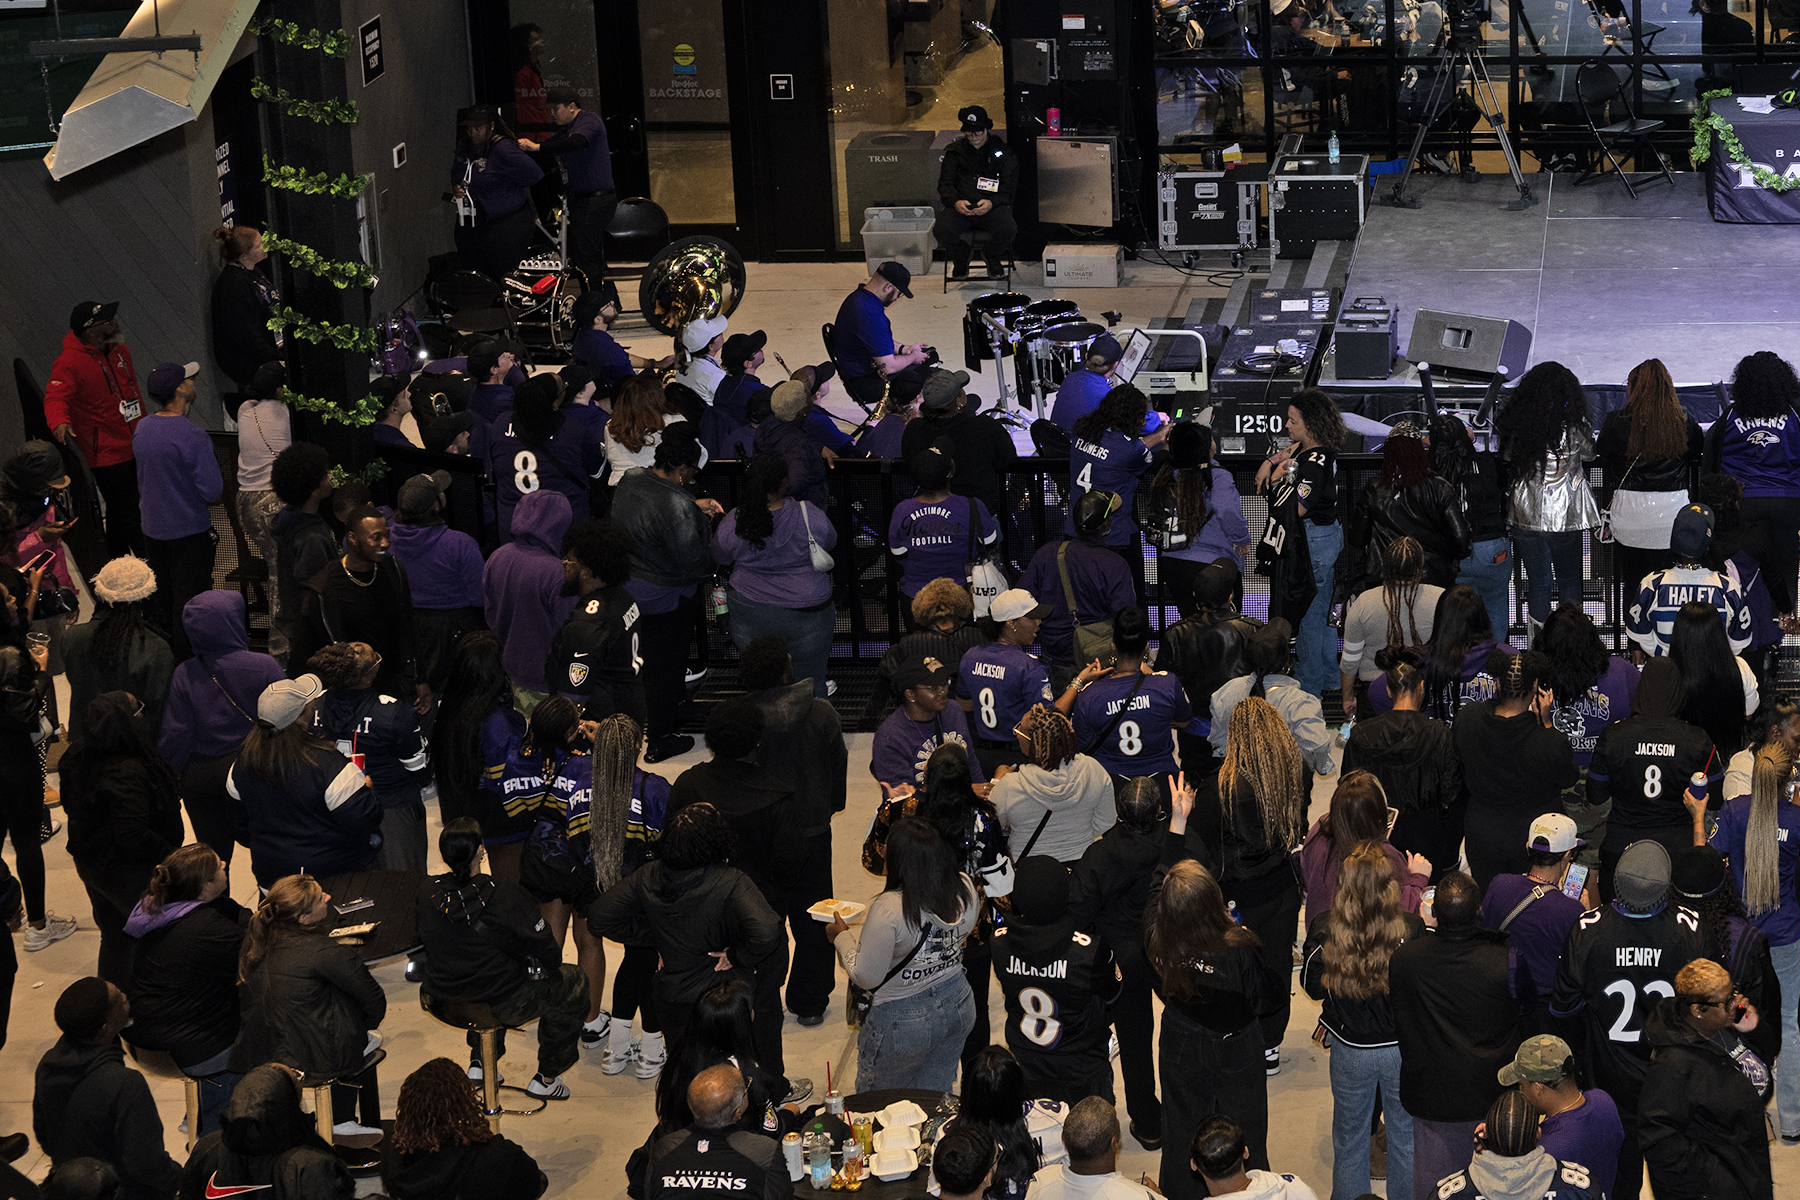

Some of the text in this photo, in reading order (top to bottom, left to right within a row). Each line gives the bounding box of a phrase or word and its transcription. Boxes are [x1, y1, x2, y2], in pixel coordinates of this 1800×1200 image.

[650, 88, 722, 98] BACKSTAGE
[1235, 414, 1282, 435] 1250
[1731, 414, 1790, 435] RAVENS
[1074, 438, 1110, 461] FLOWERS
[1307, 451, 1326, 467] 22
[513, 450, 540, 494] 8
[1076, 462, 1093, 494] 4
[910, 506, 952, 522] BALTIMORE
[910, 535, 952, 548] FOOTBALL
[585, 599, 600, 615] 8
[1739, 608, 1752, 631] 9
[971, 662, 1006, 681] JACKSON
[978, 687, 997, 729] 8
[1118, 720, 1143, 757] 8
[1635, 742, 1676, 763] JACKSON
[1642, 764, 1662, 799] 8
[1006, 955, 1068, 979] JACKSON
[1614, 945, 1663, 968] HENRY
[1019, 986, 1061, 1048] 8
[660, 1176, 748, 1191] RAVENS
